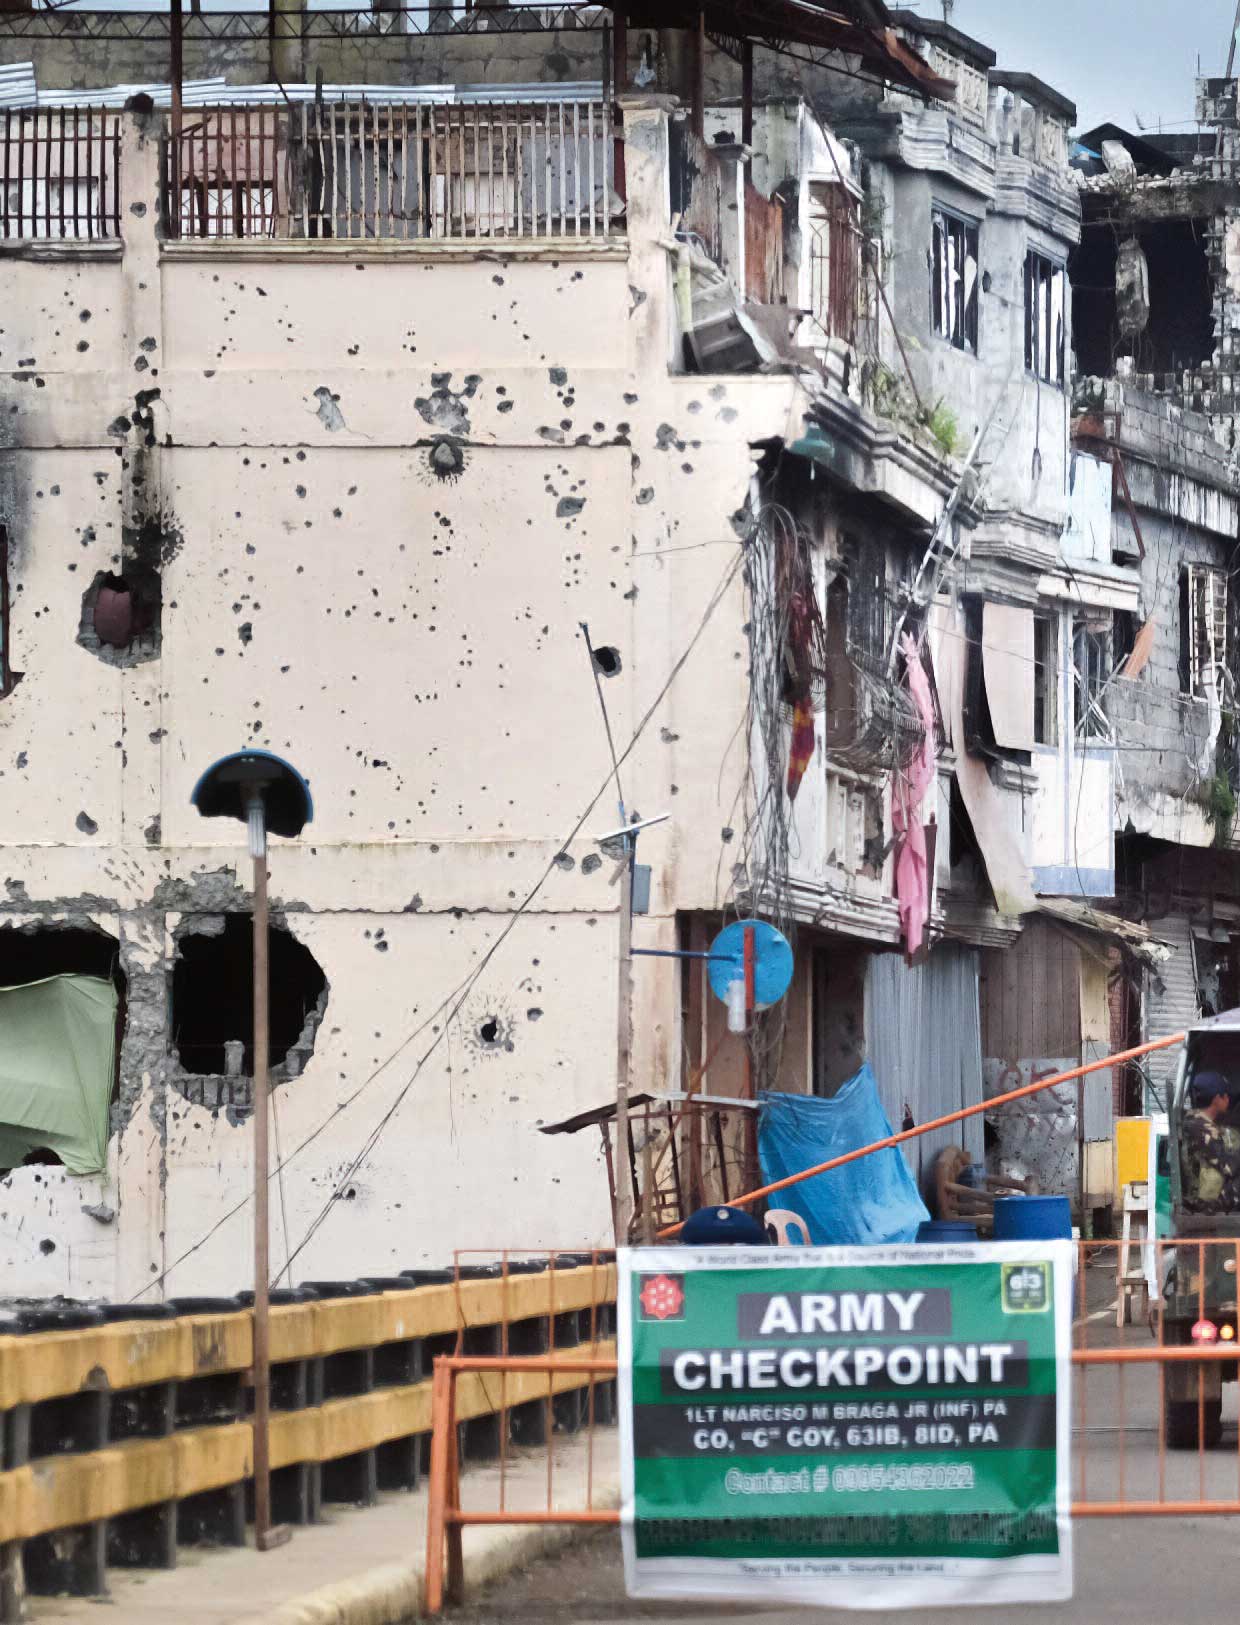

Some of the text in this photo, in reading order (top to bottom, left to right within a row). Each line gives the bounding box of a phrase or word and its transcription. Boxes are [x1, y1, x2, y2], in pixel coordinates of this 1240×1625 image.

[760, 1293, 925, 1334] ARMY
[673, 1344, 1013, 1391] CHECKPOINT
[686, 1401, 1008, 1423] 1LT NARCISO M BRAGA JR (INF) PA
[693, 1429, 735, 1451] CO,
[968, 1422, 999, 1443] PA
[724, 1466, 810, 1494] Contact
[813, 1465, 829, 1492] #
